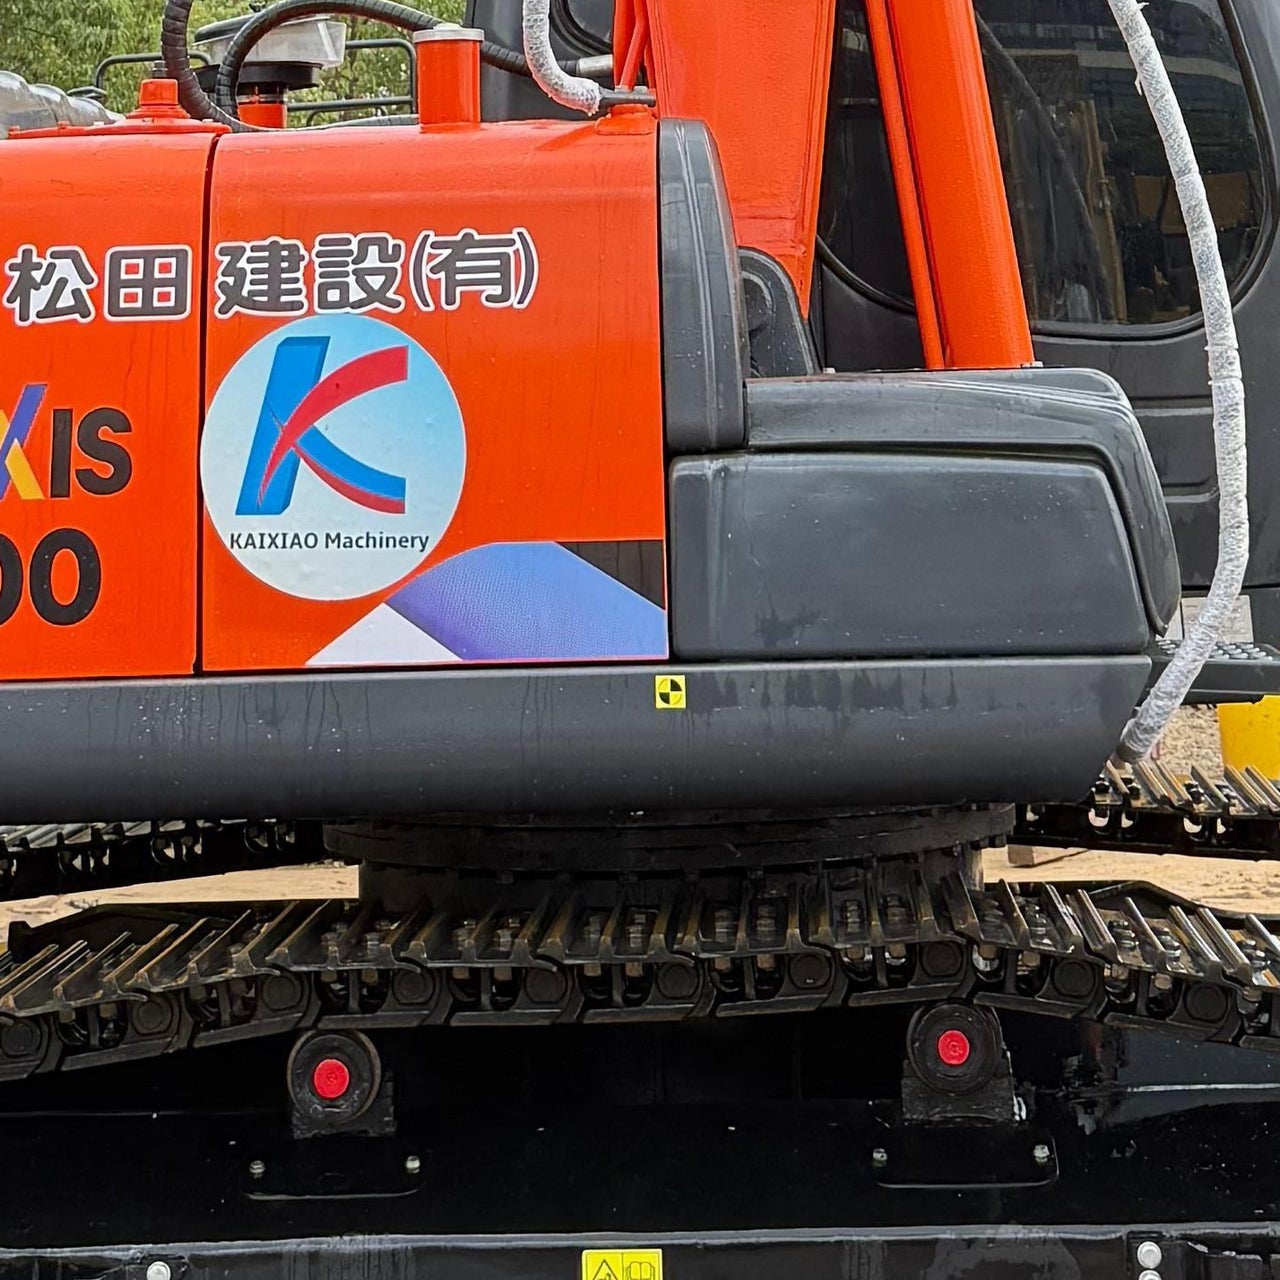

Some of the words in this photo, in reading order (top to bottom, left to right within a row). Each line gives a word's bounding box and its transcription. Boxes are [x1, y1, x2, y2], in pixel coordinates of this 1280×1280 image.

[3, 228, 539, 327] 松田建設(有)
[229, 532, 318, 550] KAIXIAO
[325, 530, 430, 553] Machinery
